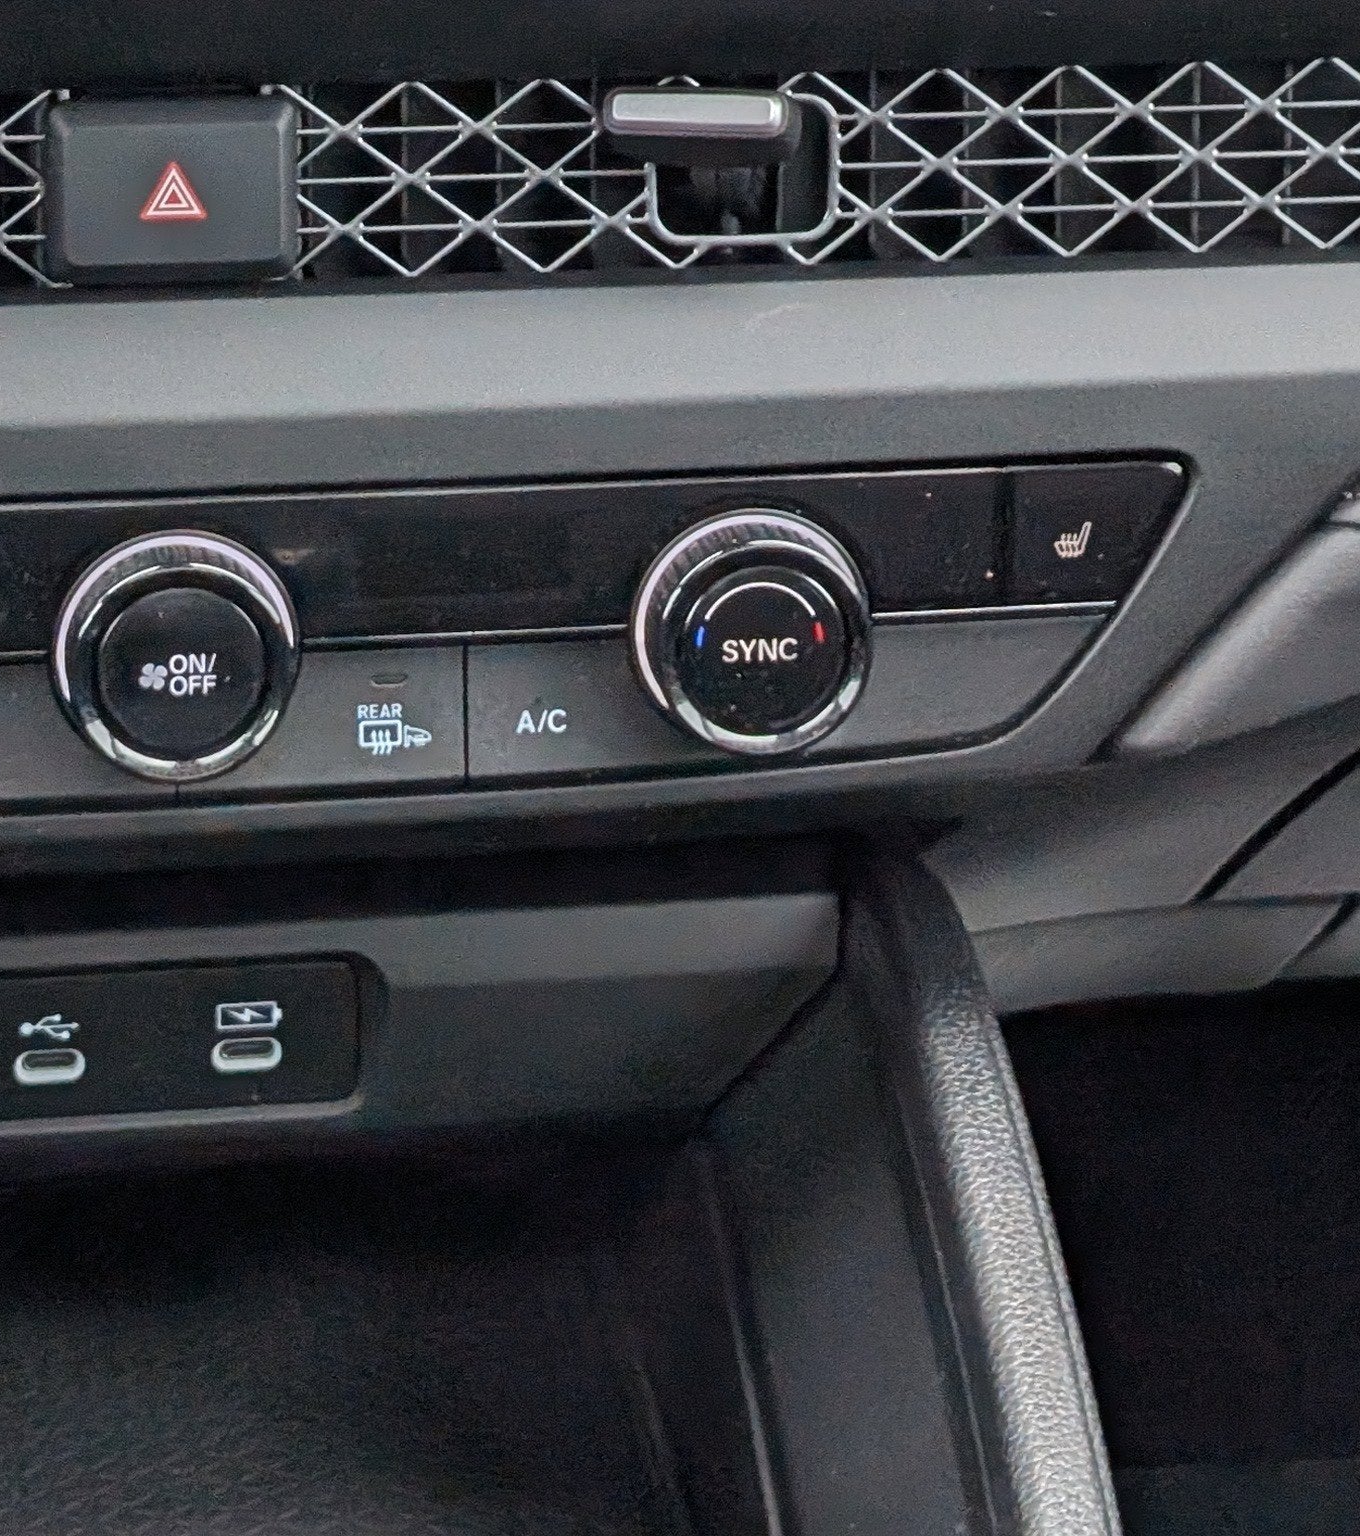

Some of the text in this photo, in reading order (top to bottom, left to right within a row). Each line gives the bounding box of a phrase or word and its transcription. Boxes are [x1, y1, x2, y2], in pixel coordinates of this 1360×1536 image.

[721, 637, 799, 663] SYNC
[168, 652, 217, 674] ON/
[169, 674, 217, 696] OFF
[357, 703, 403, 718] REAR
[515, 708, 567, 734] A/C
